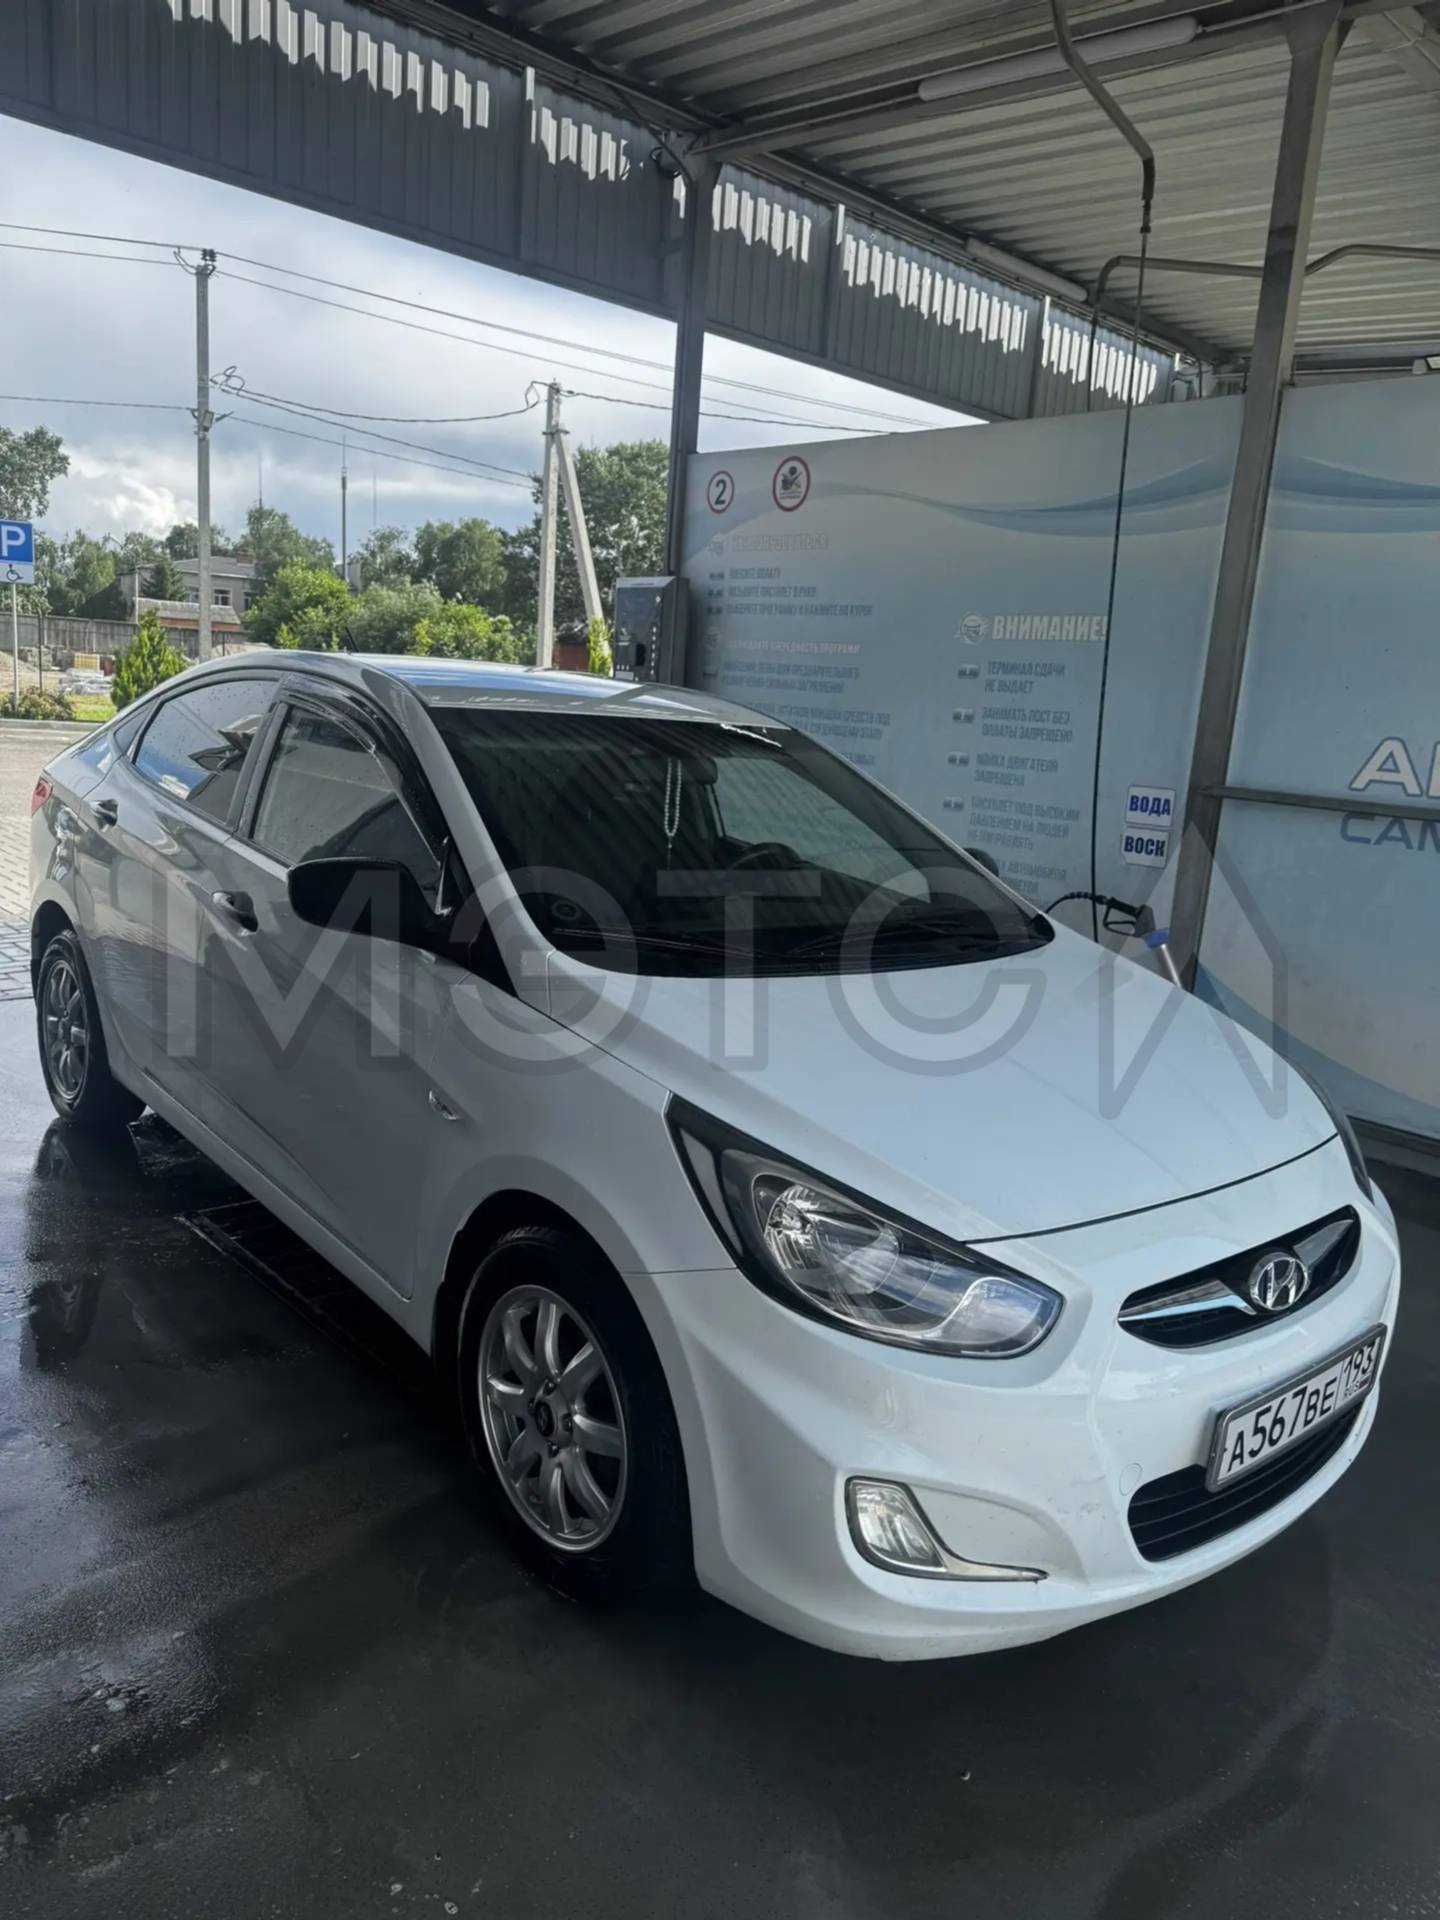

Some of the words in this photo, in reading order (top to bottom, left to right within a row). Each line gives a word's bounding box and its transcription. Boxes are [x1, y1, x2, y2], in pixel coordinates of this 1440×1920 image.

[714, 478, 727, 505] 2
[1, 525, 26, 557] P
[991, 615, 1108, 641] ВНИМАНИЕ!
[987, 660, 1032, 676] ТЕРМИНАЛ
[1034, 662, 1066, 677] СДАЧИ
[985, 679, 995, 693] НЕ
[1052, 711, 1071, 725] БЕЗ
[1019, 726, 1073, 743] ЗАПРЕЩЕНО
[1348, 736, 1440, 799] А
[1129, 795, 1171, 817] ВОДА
[1124, 836, 1166, 857] ВОСК
[1227, 1377, 1337, 1472] А567ВЕ
[1344, 1340, 1376, 1388] 193
